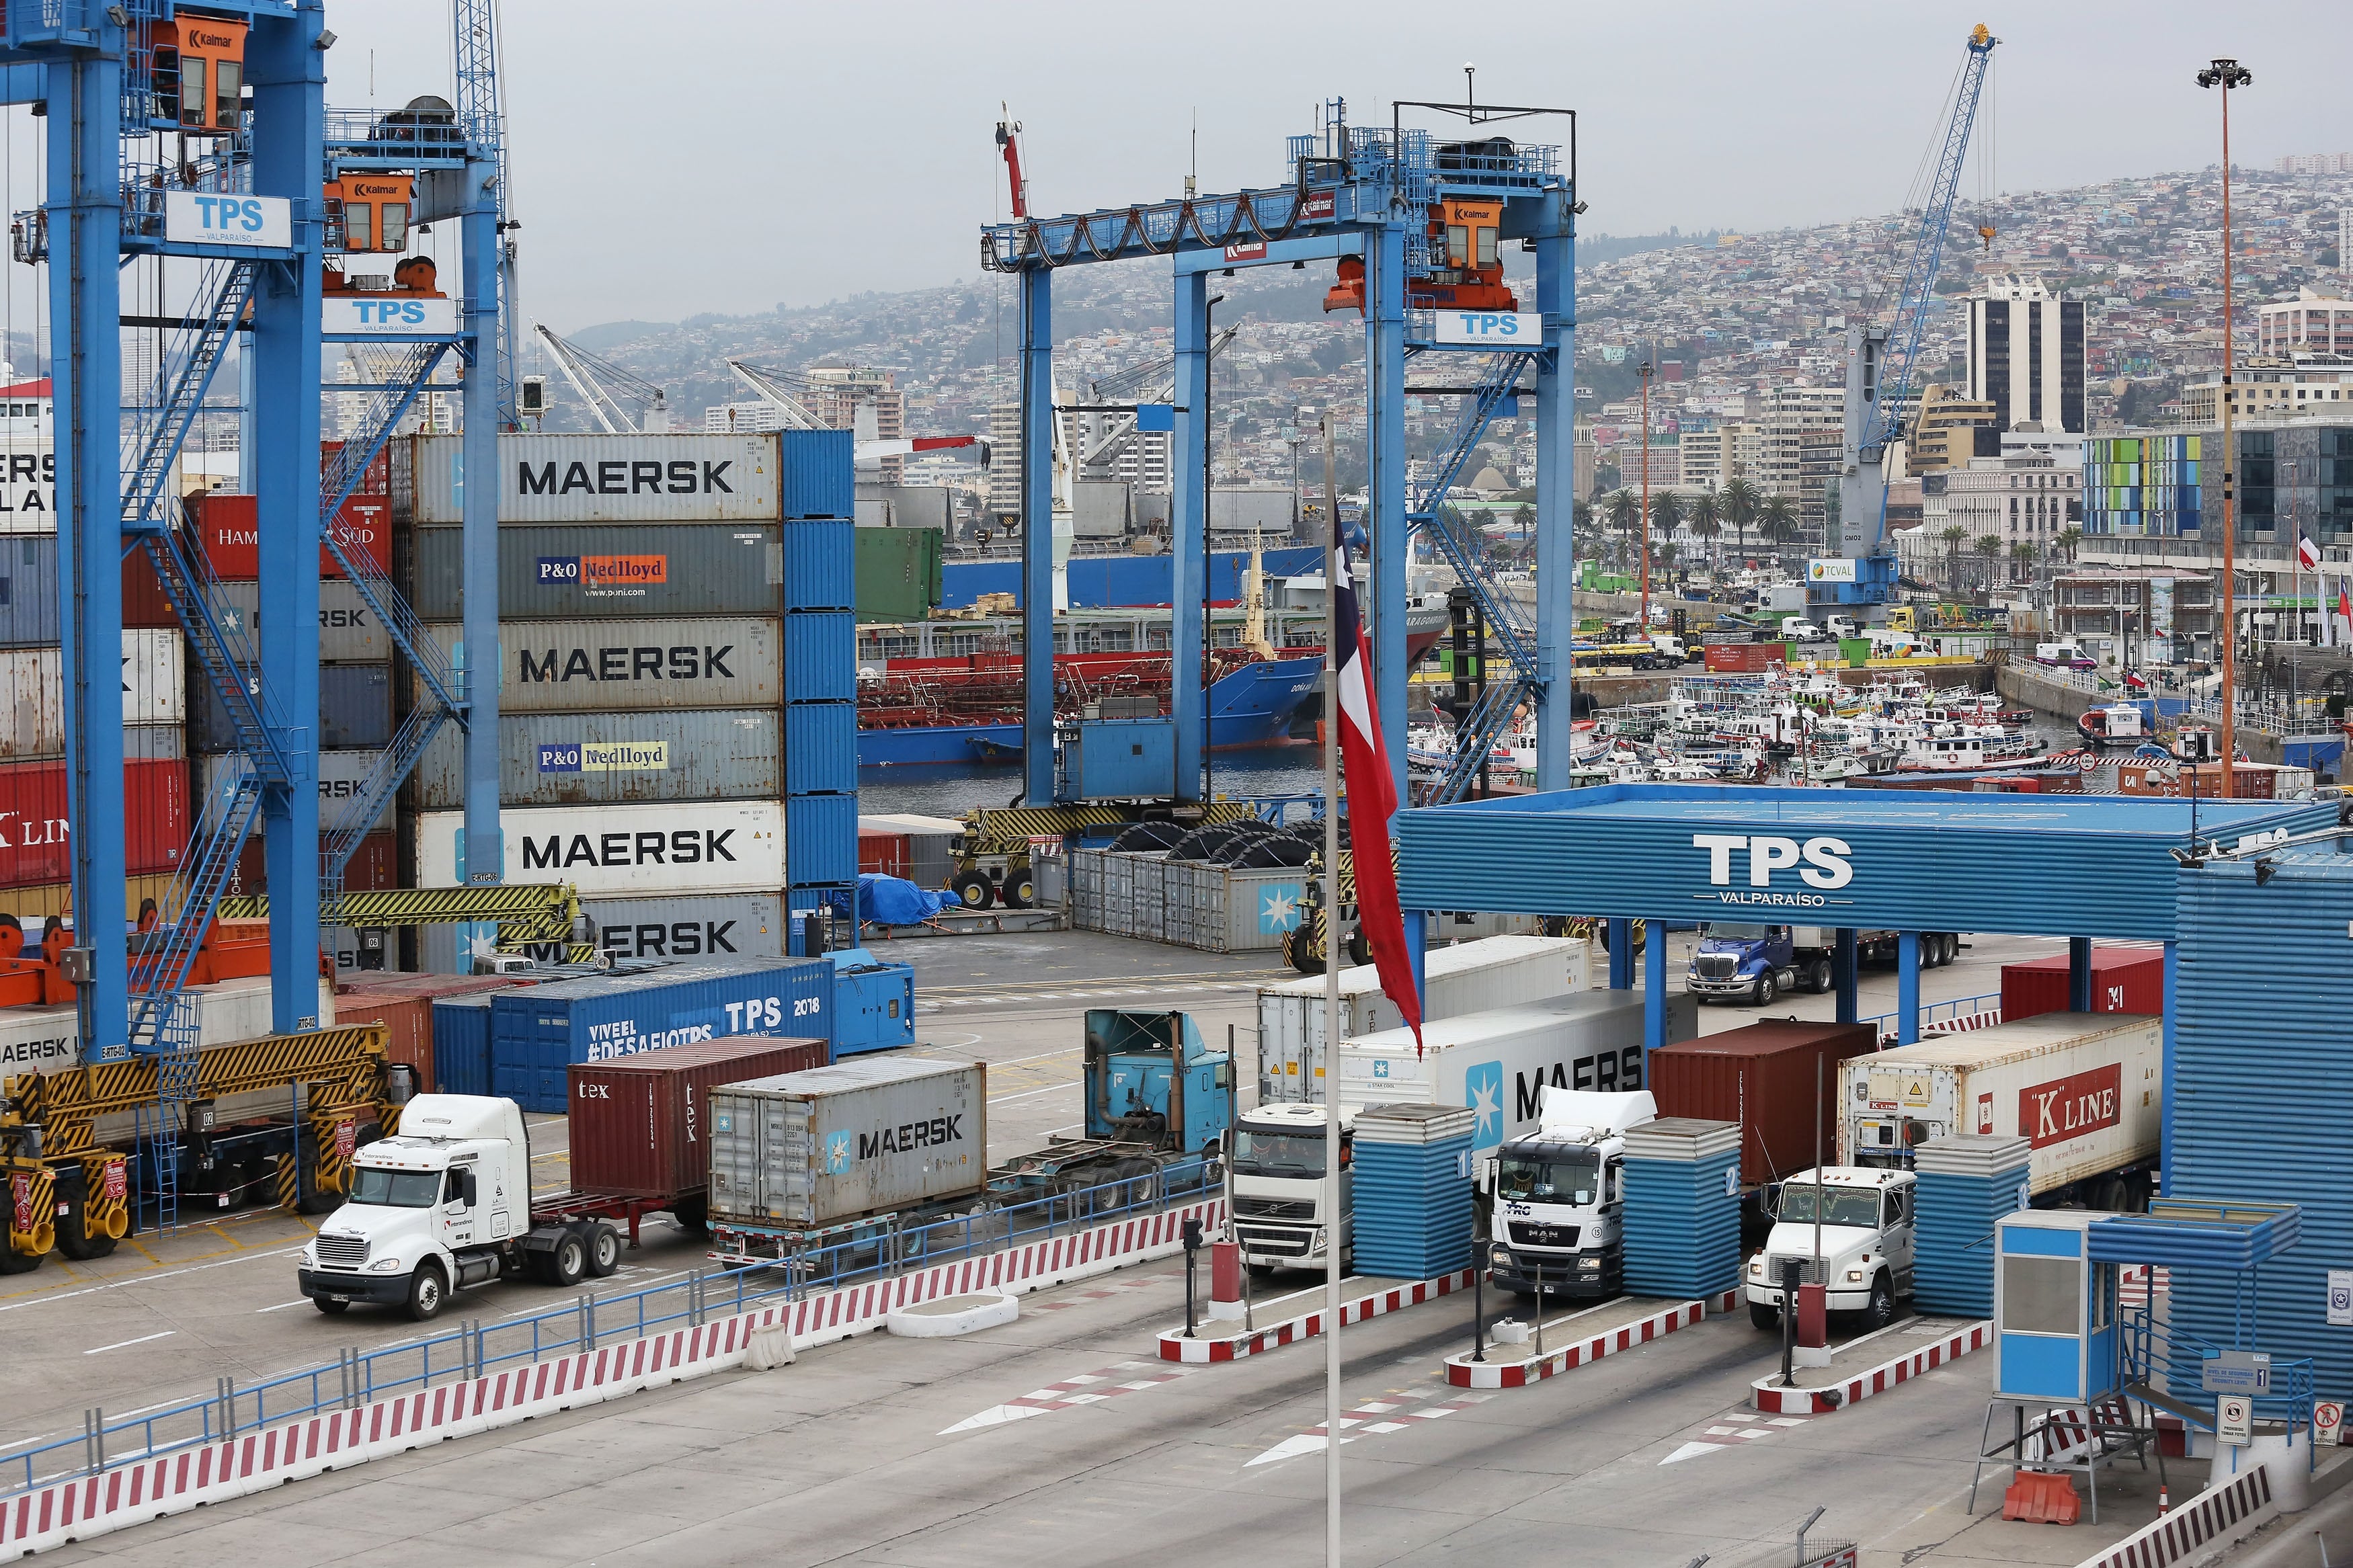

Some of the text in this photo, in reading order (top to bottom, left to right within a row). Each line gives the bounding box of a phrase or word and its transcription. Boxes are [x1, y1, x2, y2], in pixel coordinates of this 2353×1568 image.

[201, 34, 232, 48] Kalmar
[366, 185, 398, 194] Kalmar
[195, 196, 264, 232] TPS
[1464, 210, 1490, 219] Kalmar
[206, 233, 252, 242] VALPARAÍSO
[352, 301, 426, 324] TPS
[1460, 315, 1518, 335] TPS
[519, 460, 733, 495] MAERSK
[540, 560, 662, 579] P&O Nedlloyd
[1825, 567, 1851, 576] TCVAL
[585, 587, 646, 597] www.poni.com
[520, 645, 735, 683] MAERSK
[542, 746, 664, 766] P&O Nedlloyd
[319, 780, 369, 798] RSK
[22, 819, 70, 846] LIN
[522, 829, 737, 870] MAERSK
[1693, 834, 1853, 889] TPS
[473, 873, 497, 882] E-RTG-06
[1719, 891, 1825, 907] VALPARAÍSO
[370, 938, 377, 946] 06
[524, 920, 738, 962] MERSK
[725, 997, 820, 1032] TPS 2018
[0, 1037, 68, 1063] AERSK
[102, 1044, 126, 1059] E-RTG-02
[578, 1080, 610, 1099] tex
[1515, 1044, 1642, 1123] MAERS
[204, 1113, 212, 1125] 02
[686, 1083, 696, 1143] tex
[2064, 1087, 2115, 1131] LINE
[859, 1114, 963, 1160] MAERSK
[108, 1167, 124, 1175] PELIGRO
[1459, 1150, 1467, 1179] 1
[1726, 1166, 1736, 1196] 2
[2020, 1183, 2027, 1211] 3
[451, 1219, 473, 1227] interandinos
[1528, 1229, 1558, 1238] MAN
[2259, 1370, 2266, 1386] 1
